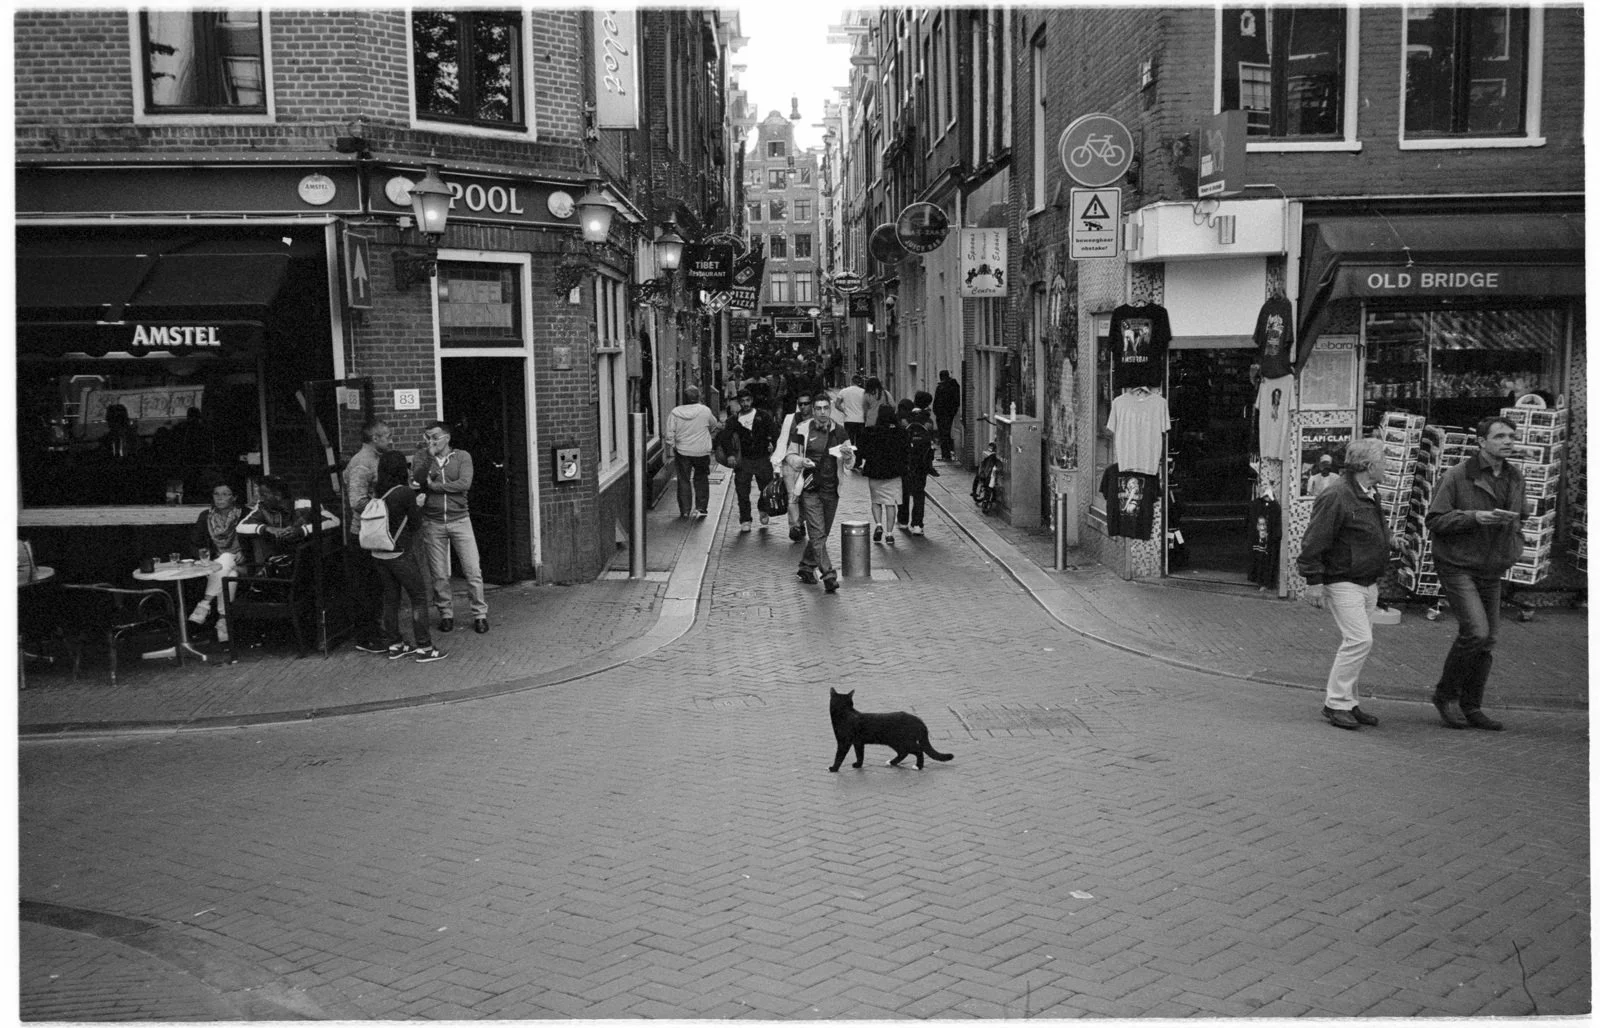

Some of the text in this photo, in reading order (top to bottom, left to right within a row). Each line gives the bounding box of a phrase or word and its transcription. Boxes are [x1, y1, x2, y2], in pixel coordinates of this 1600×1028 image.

[602, 10, 629, 96] elot
[448, 183, 524, 215] POOL
[695, 261, 721, 270] TIBET
[1367, 272, 1499, 289] OLD BRIDGE
[730, 290, 755, 300] PIZZA
[731, 300, 755, 309] PIZZA
[132, 325, 221, 347] AMSTEL
[1314, 341, 1353, 350] Lebara
[399, 394, 415, 404] 83
